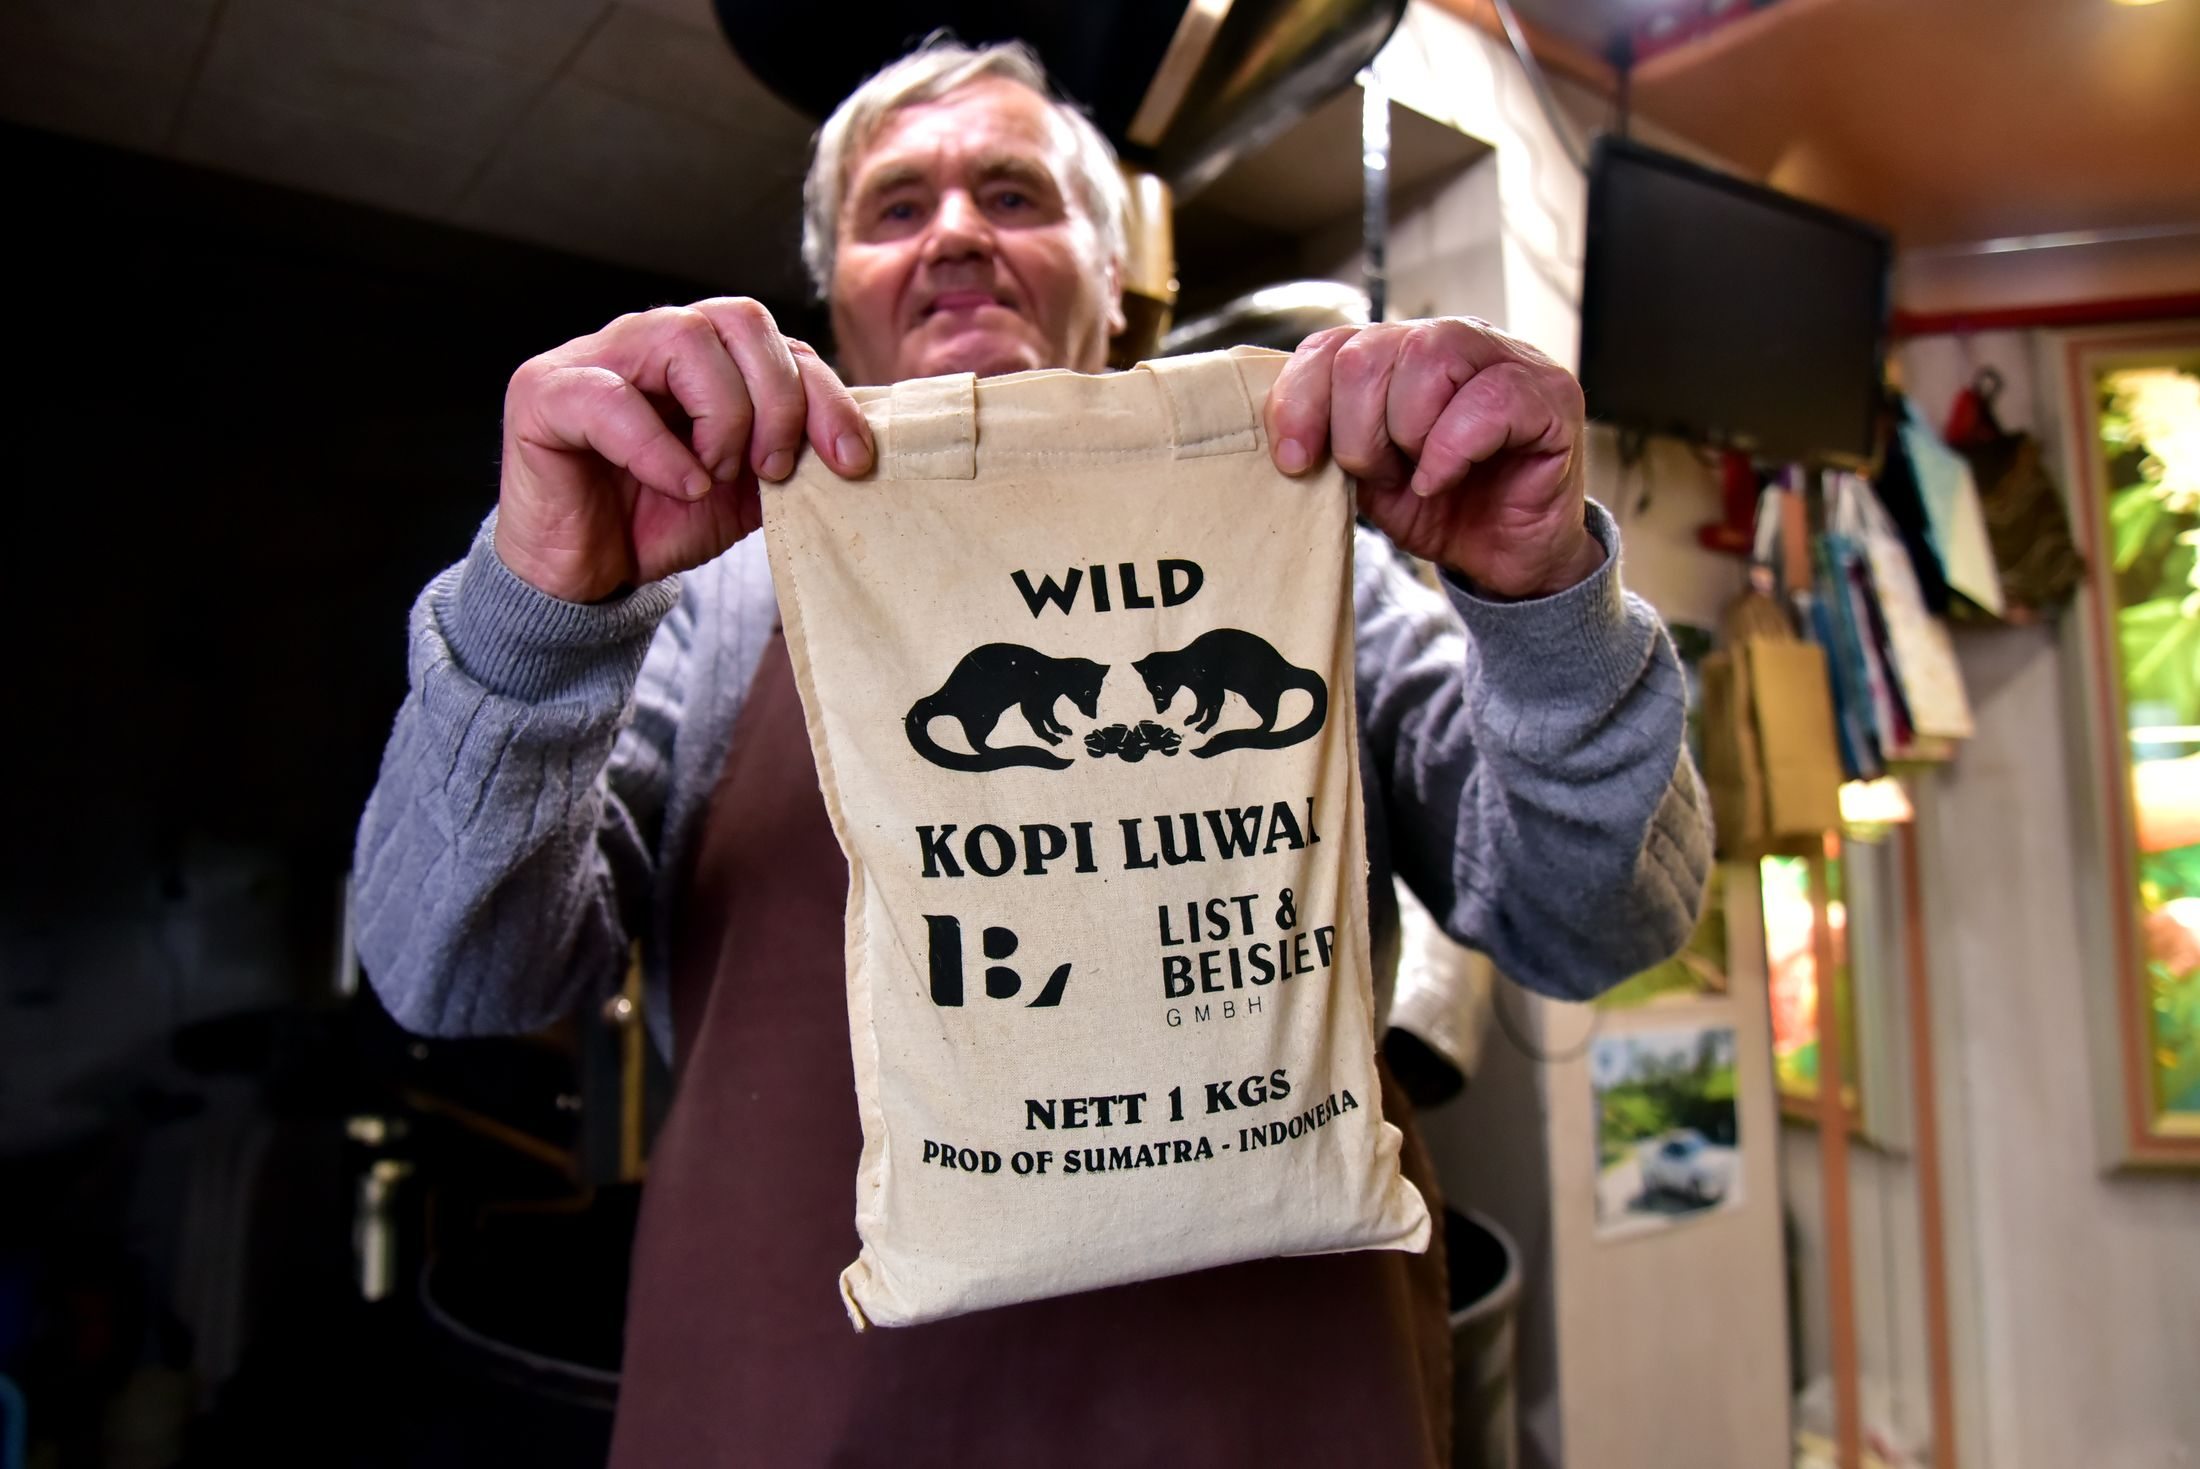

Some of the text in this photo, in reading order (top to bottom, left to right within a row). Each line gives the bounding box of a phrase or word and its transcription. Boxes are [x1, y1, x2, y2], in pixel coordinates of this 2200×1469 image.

[1010, 558, 1204, 619] WILD
[915, 823, 1098, 878] KOPI
[1158, 887, 1298, 947] LIST &
[1162, 924, 1338, 999] BEISLER
[1024, 1068, 1291, 1131] NETT 1 KGS
[922, 1139, 1002, 1174] PROD
[1010, 1150, 1054, 1175] OF
[1062, 1136, 1214, 1174] SUMATRA
[1238, 1089, 1359, 1153] INDONESIA
